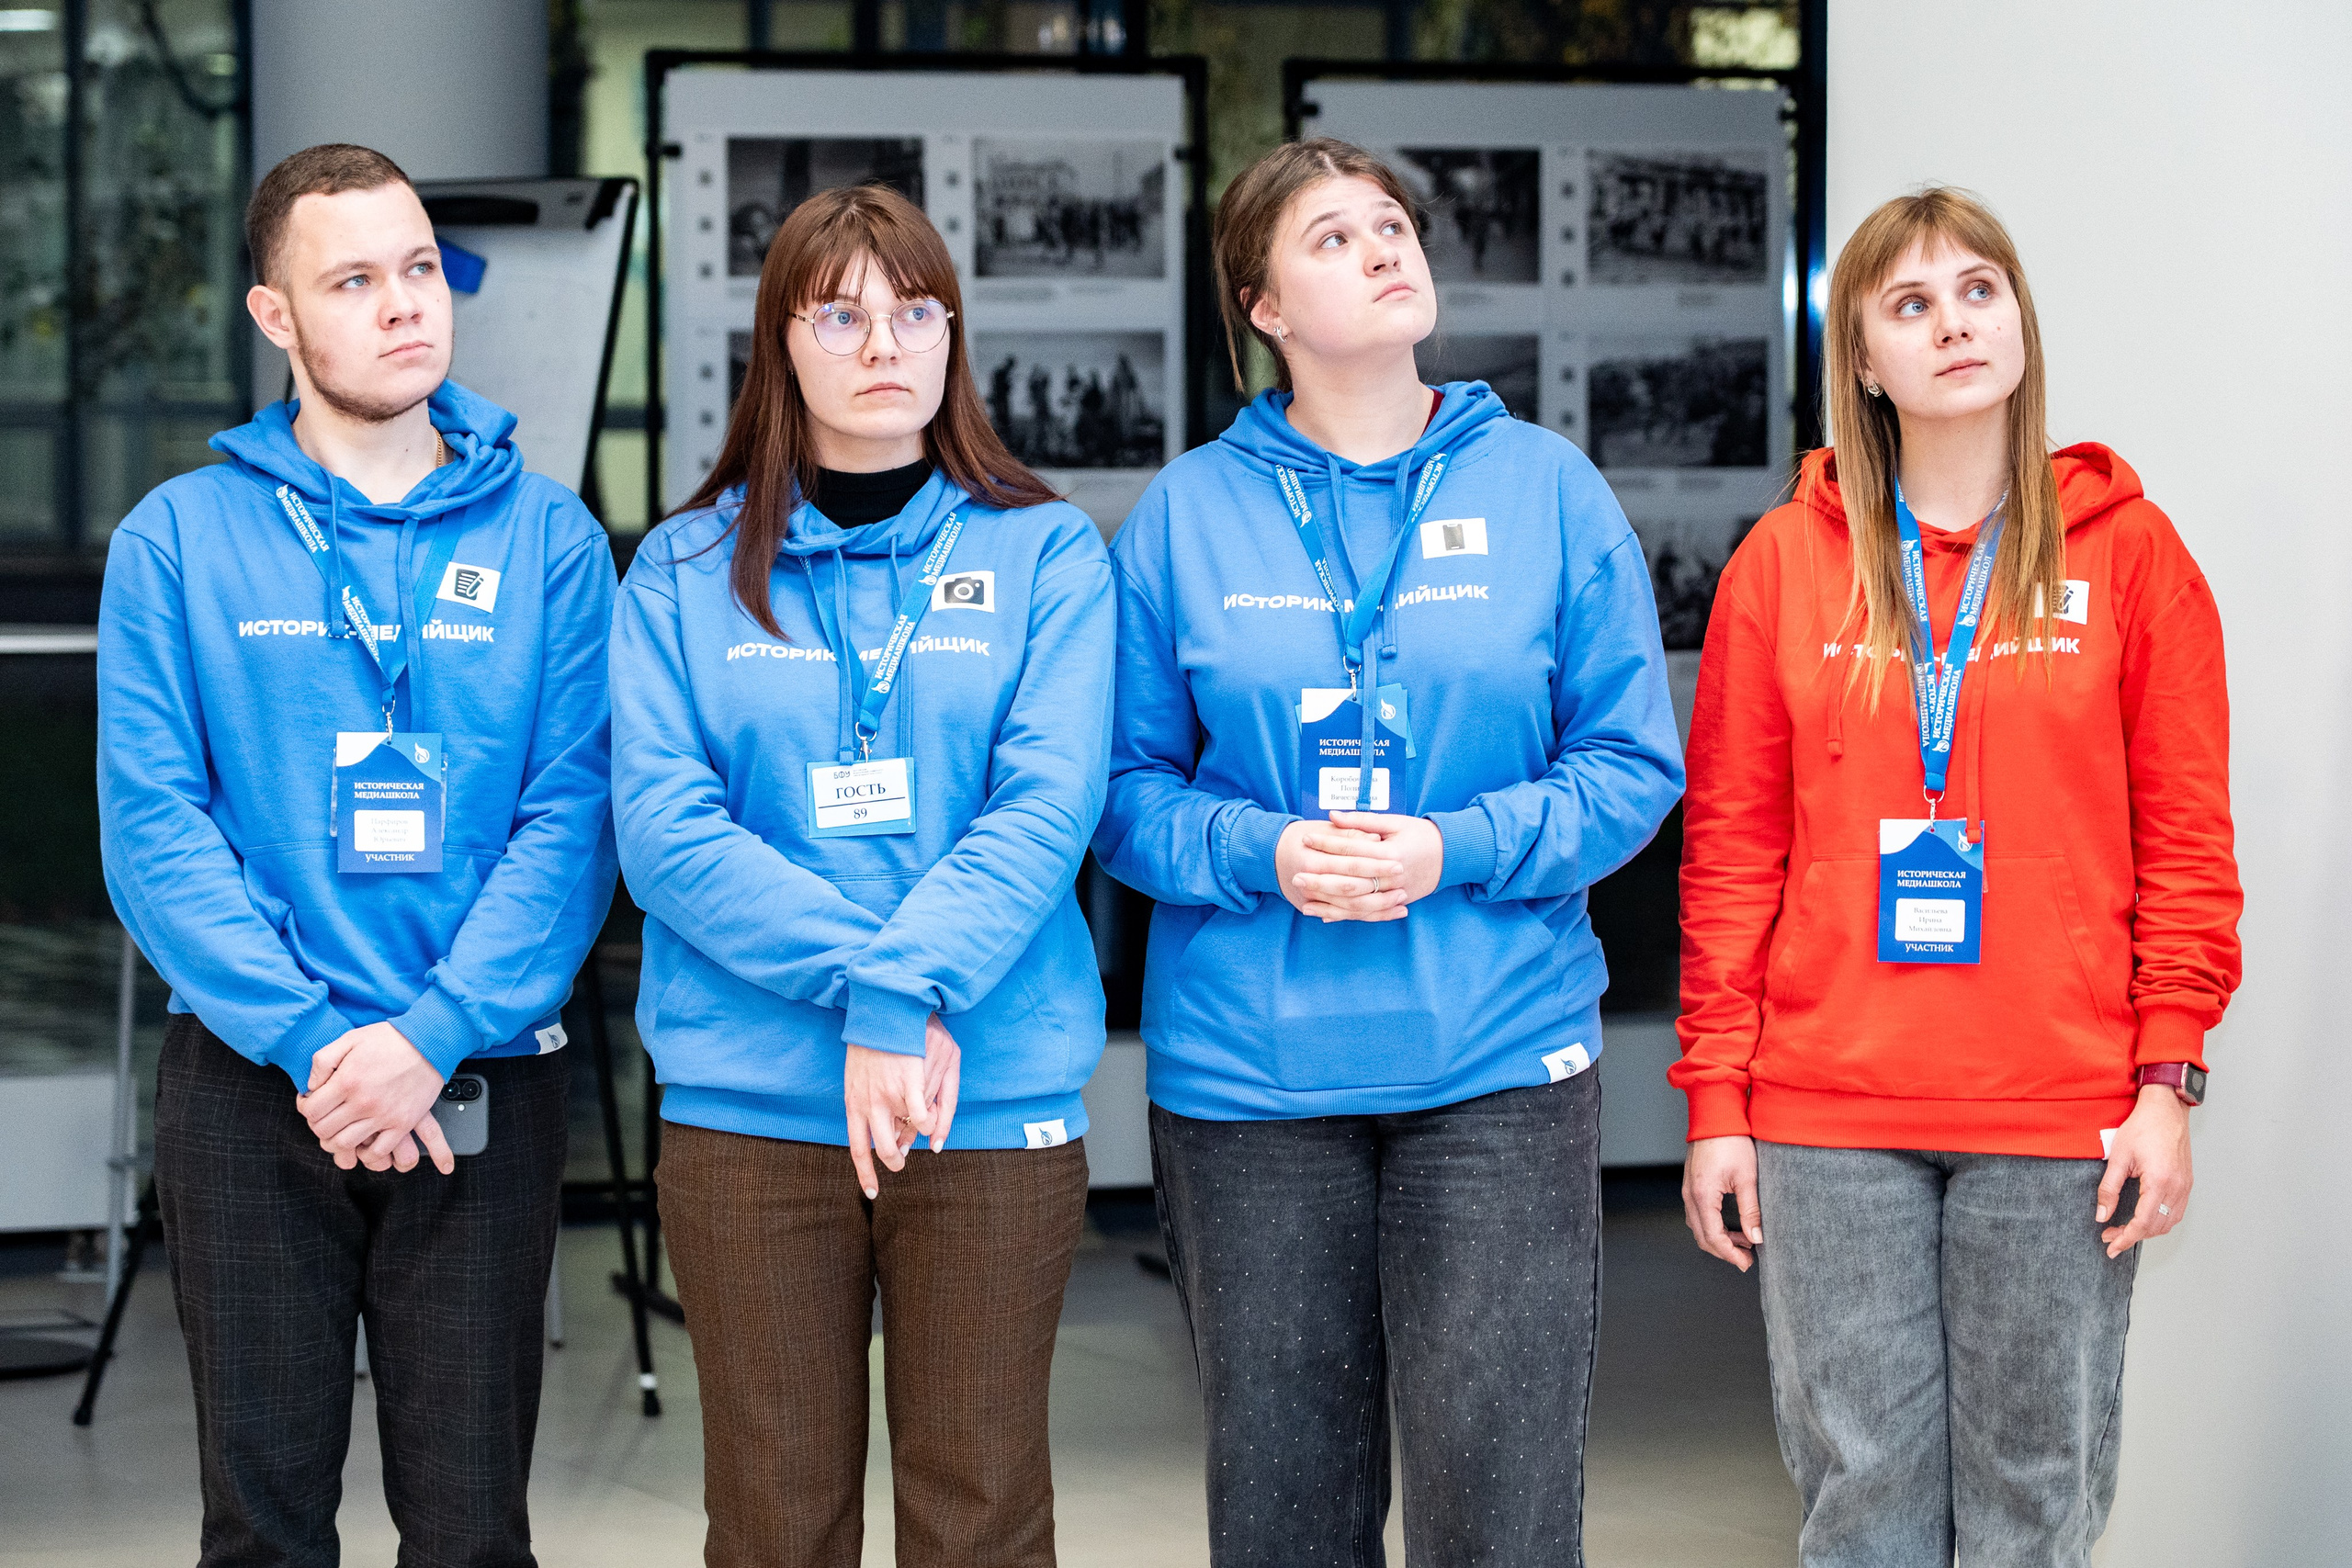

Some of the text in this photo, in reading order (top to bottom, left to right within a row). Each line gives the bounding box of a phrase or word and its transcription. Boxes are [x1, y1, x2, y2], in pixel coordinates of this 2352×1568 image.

[1286, 468, 1309, 512] МЕДИАШКО
[280, 497, 319, 553] МЕДИАШКОЛА
[288, 491, 330, 552] ИСТОРИЧЕСКАЯ
[922, 512, 957, 573] ИСТОРИЧЕСКАЯ
[932, 521, 963, 577] МЕДИАШКОЛА
[1912, 550, 1928, 622] ИСТОРИЧЕСКАЯ
[1970, 555, 1993, 615] МЕДИАШКОЛ
[875, 614, 909, 679] ИСТОРИЧЕСКАЯ
[884, 621, 916, 682] МЕДИАШКОЛА
[1932, 663, 1954, 739] ИСТОРИЧЕСКАЯ
[1941, 669, 1962, 740] МЕДИАШКОЛА
[1319, 739, 1390, 747] ИСТОРИЧКАЯ
[354, 782, 424, 790] ИСТОРИЧЕСКАЯ
[354, 791, 420, 799] МЕДИАШКОЛА
[836, 783, 886, 799] ГОСТЬ
[854, 807, 867, 819] 89
[365, 853, 415, 863] УЧАСТНИК
[1897, 870, 1966, 879] ИСТОРИЧЕСКАЯ
[1896, 879, 1962, 888] МЕДИАШКОЛА
[1905, 942, 1954, 953] УЧАСТНИК
